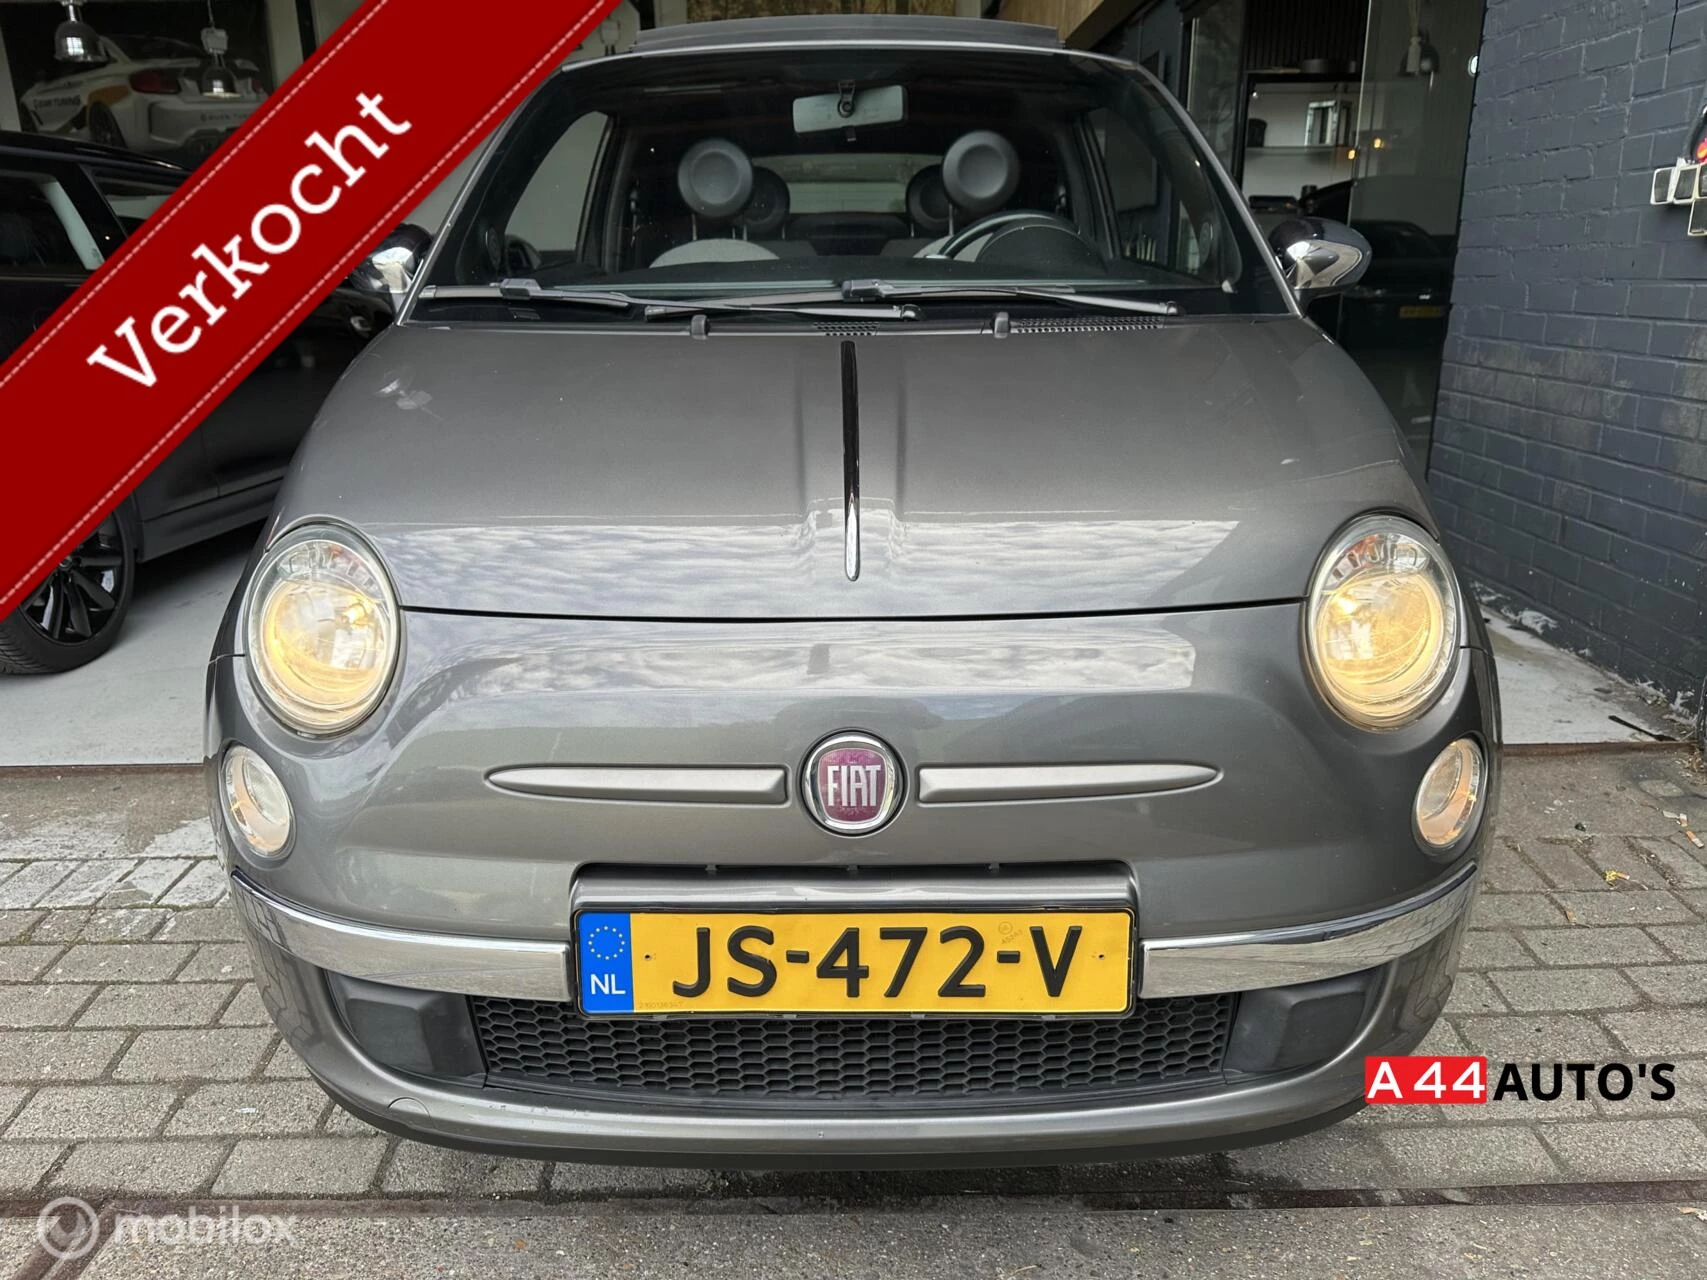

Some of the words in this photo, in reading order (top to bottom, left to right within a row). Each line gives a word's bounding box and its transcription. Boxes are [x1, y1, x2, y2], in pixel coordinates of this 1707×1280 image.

[827, 765, 881, 806] FIAT
[672, 926, 1083, 998] JS-472-V
[590, 974, 625, 995] NL
